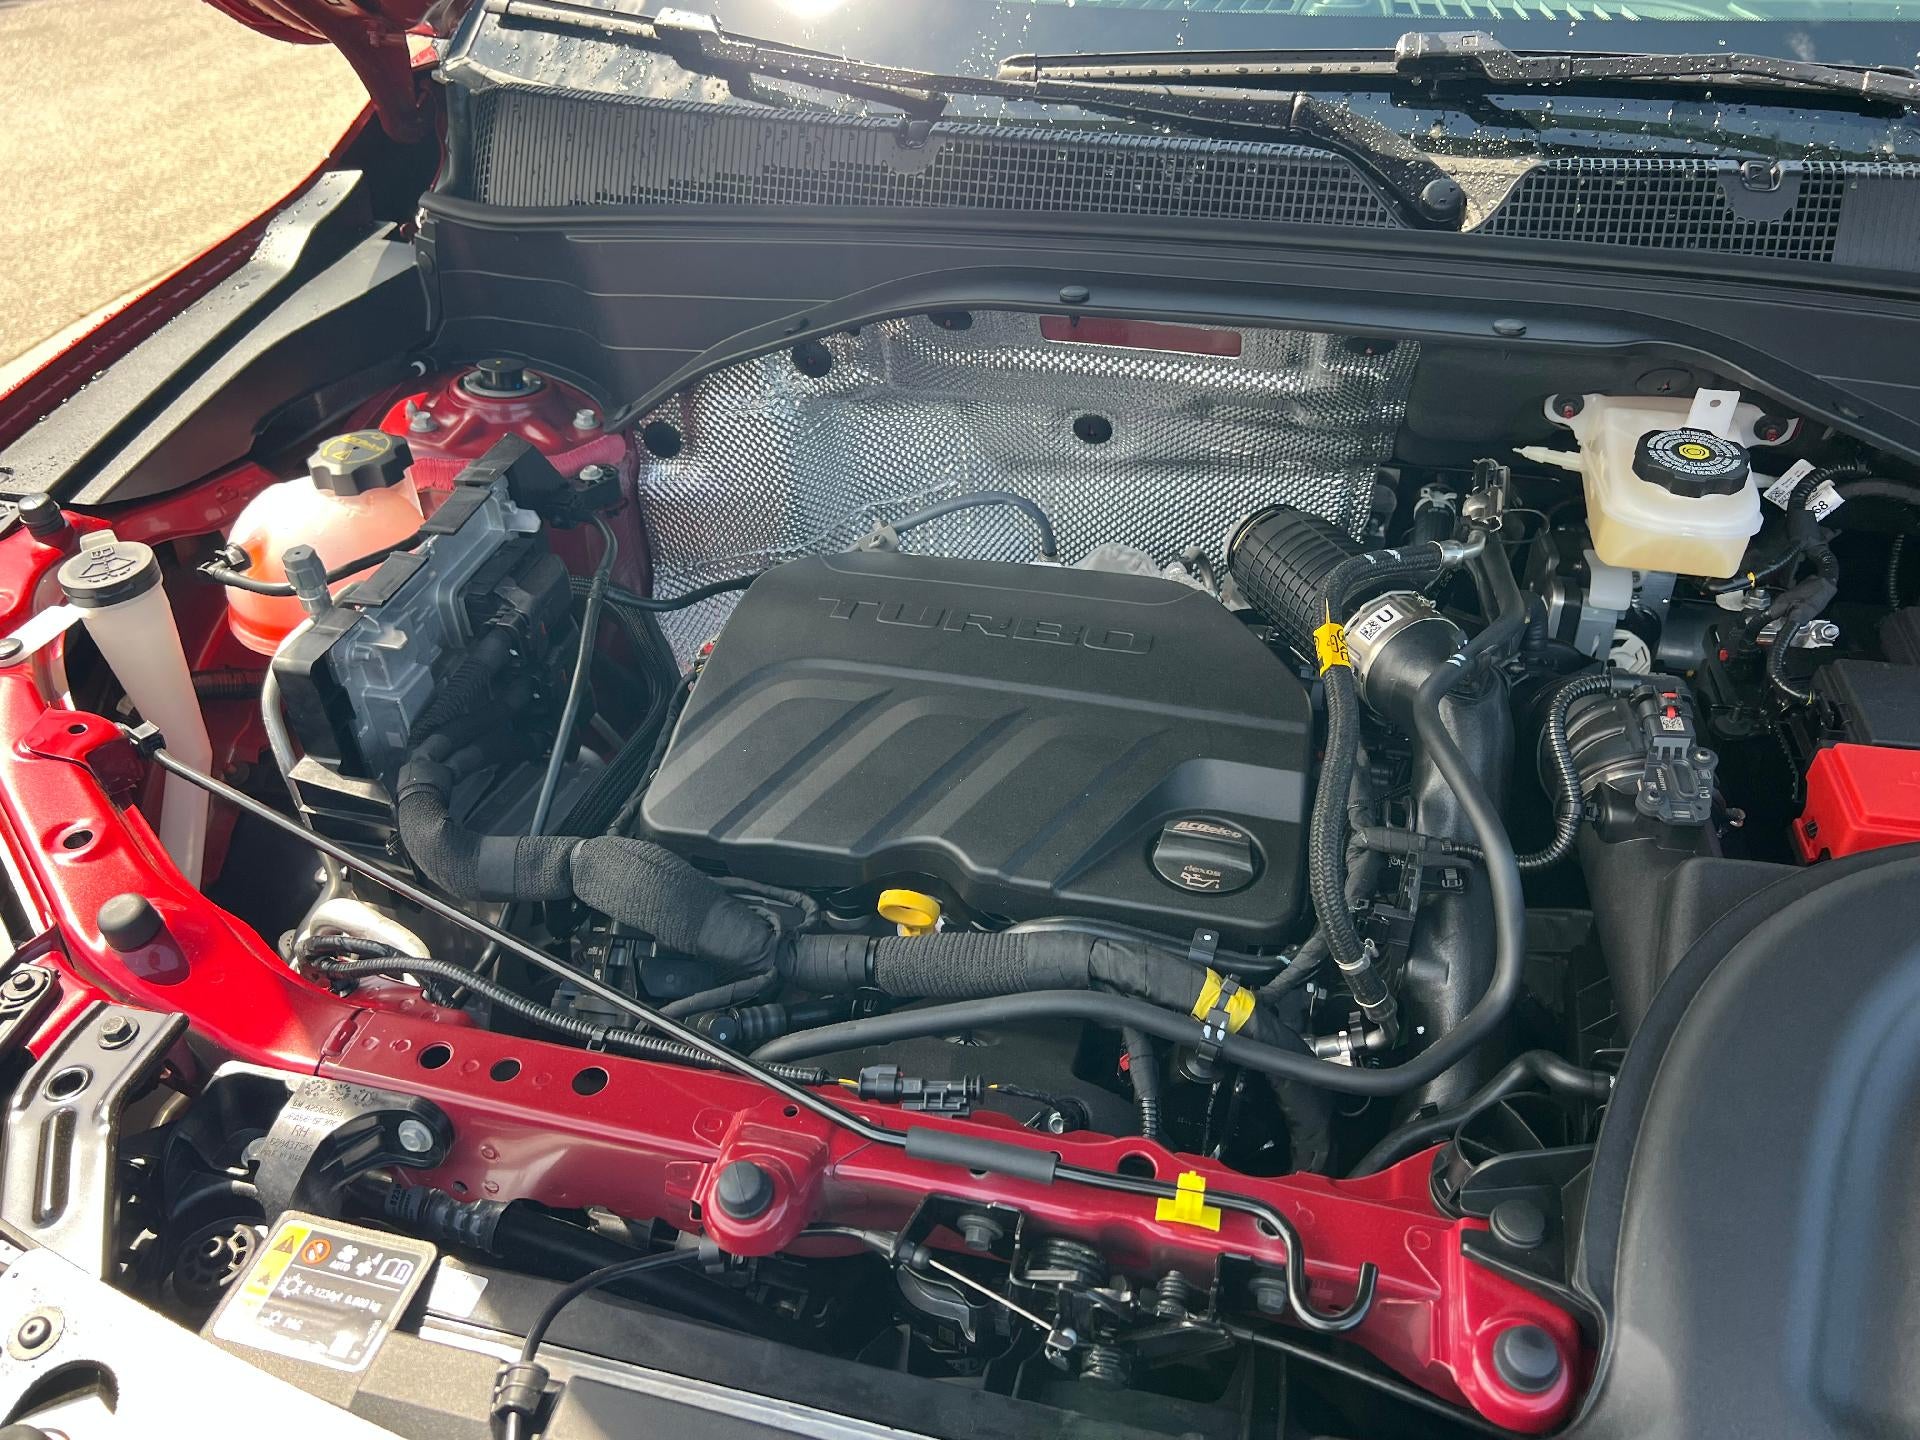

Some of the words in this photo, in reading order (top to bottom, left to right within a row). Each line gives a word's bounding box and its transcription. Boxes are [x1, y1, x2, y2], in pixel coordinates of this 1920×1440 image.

[1376, 609, 1394, 623] U
[818, 597, 1155, 655] TURBO
[1173, 821, 1243, 838] ACDelco
[1183, 864, 1221, 877] dexos
[291, 1125, 310, 1138] RH
[329, 1261, 351, 1272] AUTO
